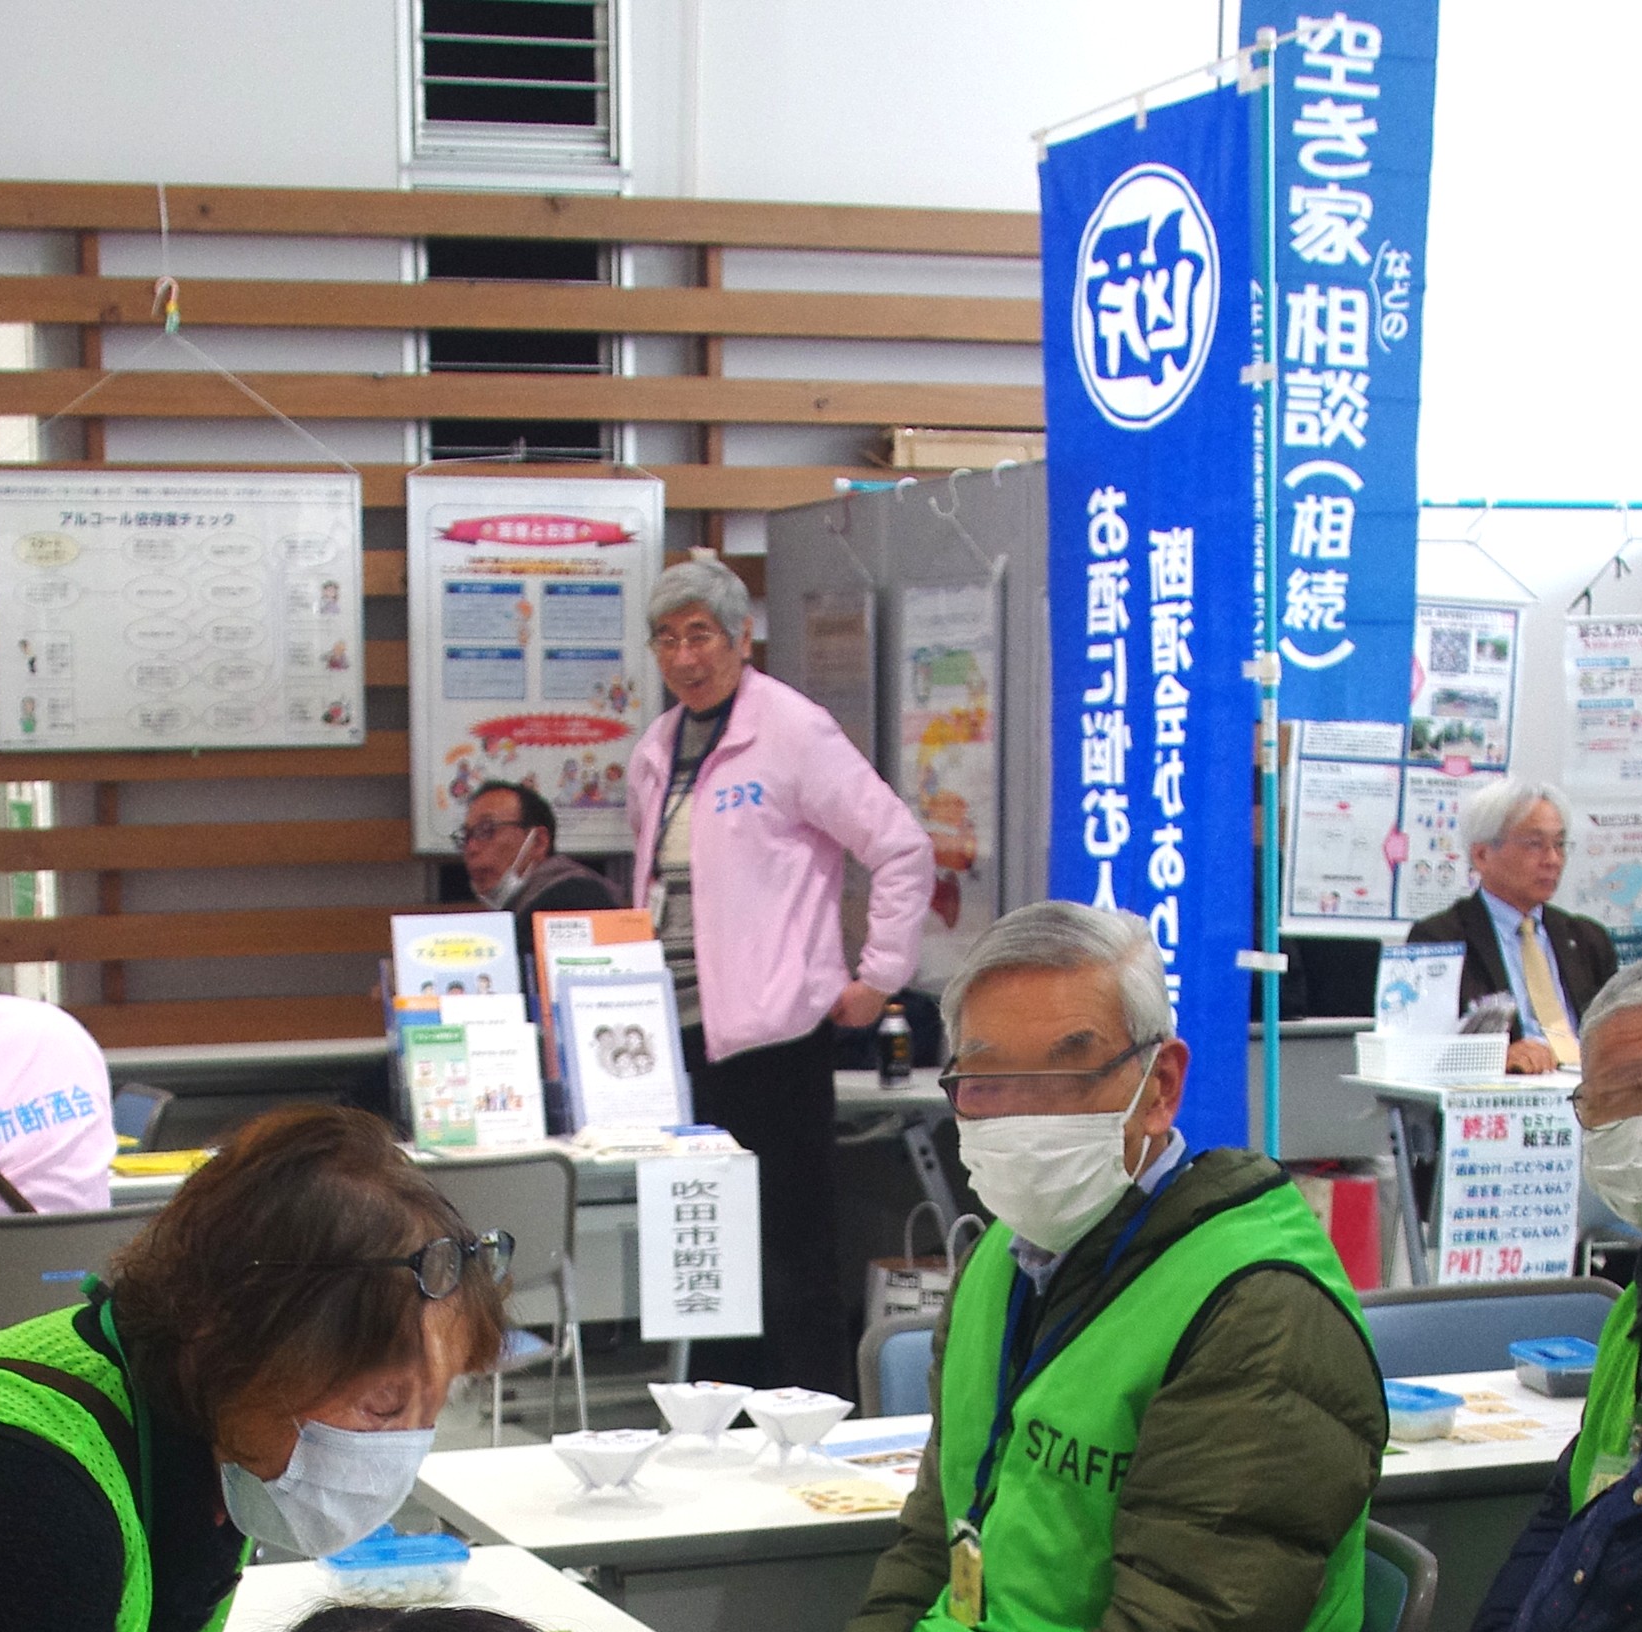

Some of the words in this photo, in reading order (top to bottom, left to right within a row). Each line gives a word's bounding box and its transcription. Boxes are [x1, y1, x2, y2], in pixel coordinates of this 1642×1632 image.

[1382, 246, 1411, 343] などの
[671, 1179, 721, 1314] 吹田市断酒会
[1026, 1419, 1133, 1494] STAFF
